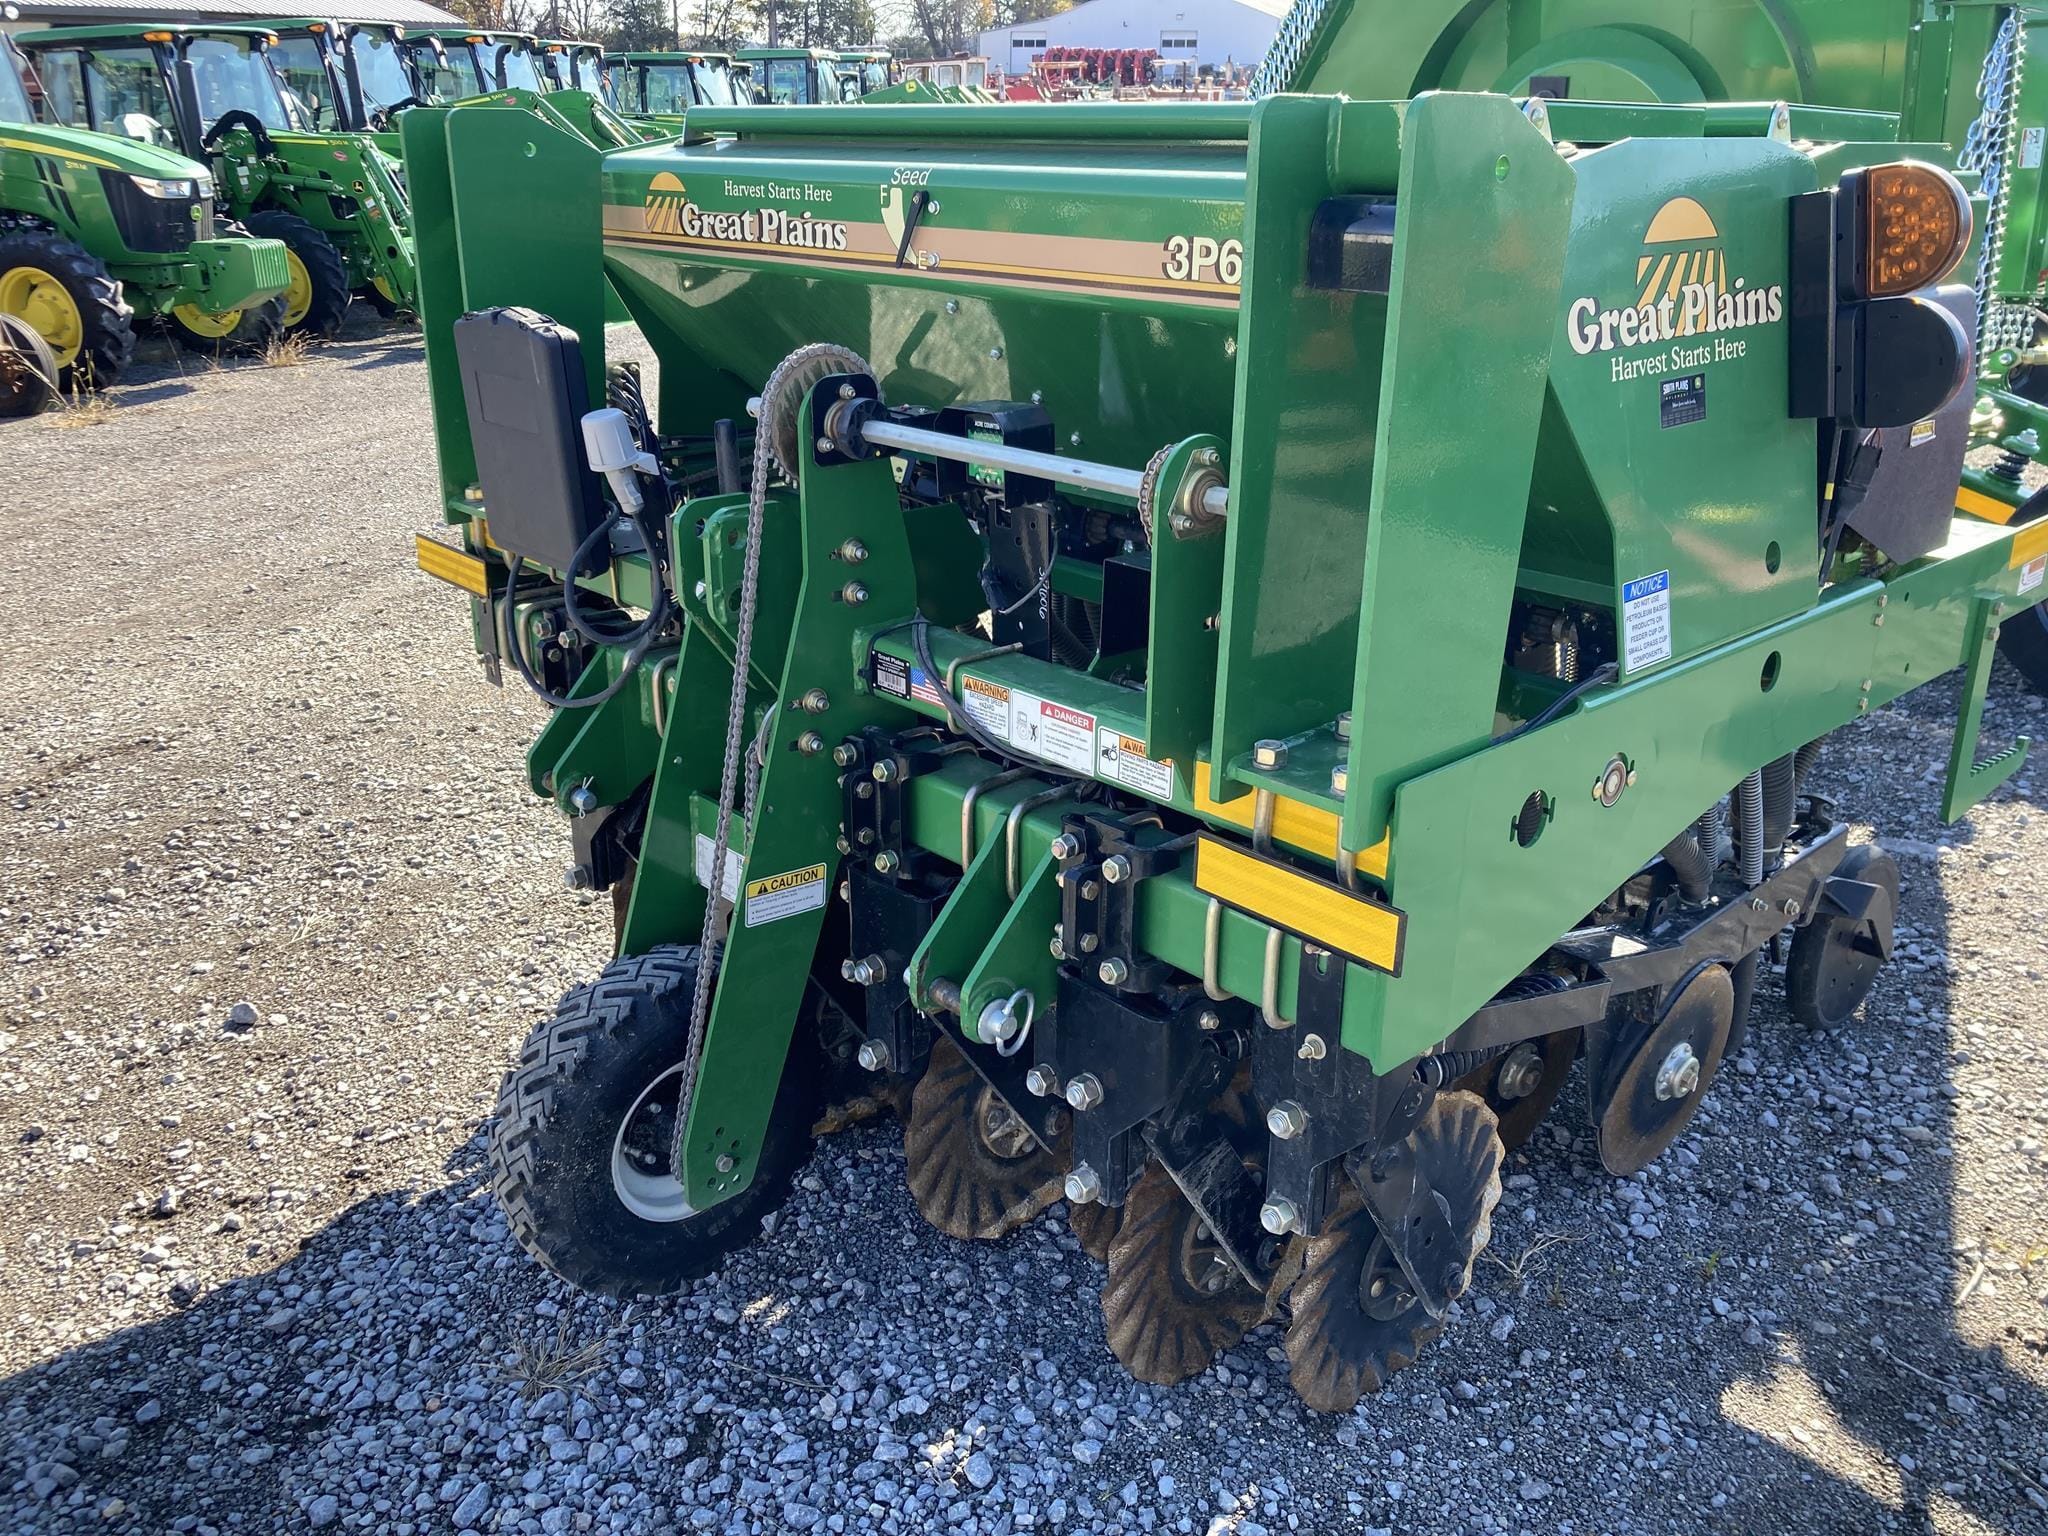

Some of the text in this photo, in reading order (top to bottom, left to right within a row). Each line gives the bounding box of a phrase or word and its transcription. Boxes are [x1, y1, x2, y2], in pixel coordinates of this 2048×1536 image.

[890, 167, 933, 186] Seed
[724, 180, 832, 202] Harvest Starts Here
[880, 184, 888, 205] F
[680, 201, 848, 251] Great Plains
[918, 250, 927, 270] E
[1567, 276, 1783, 356] Great Plains
[1610, 337, 1746, 383] Harvest Starts Here
[1629, 574, 1664, 598] NOTICE
[971, 679, 1008, 701] WARNING
[1054, 708, 1090, 729] DANGER
[770, 868, 818, 891] CAUTION
